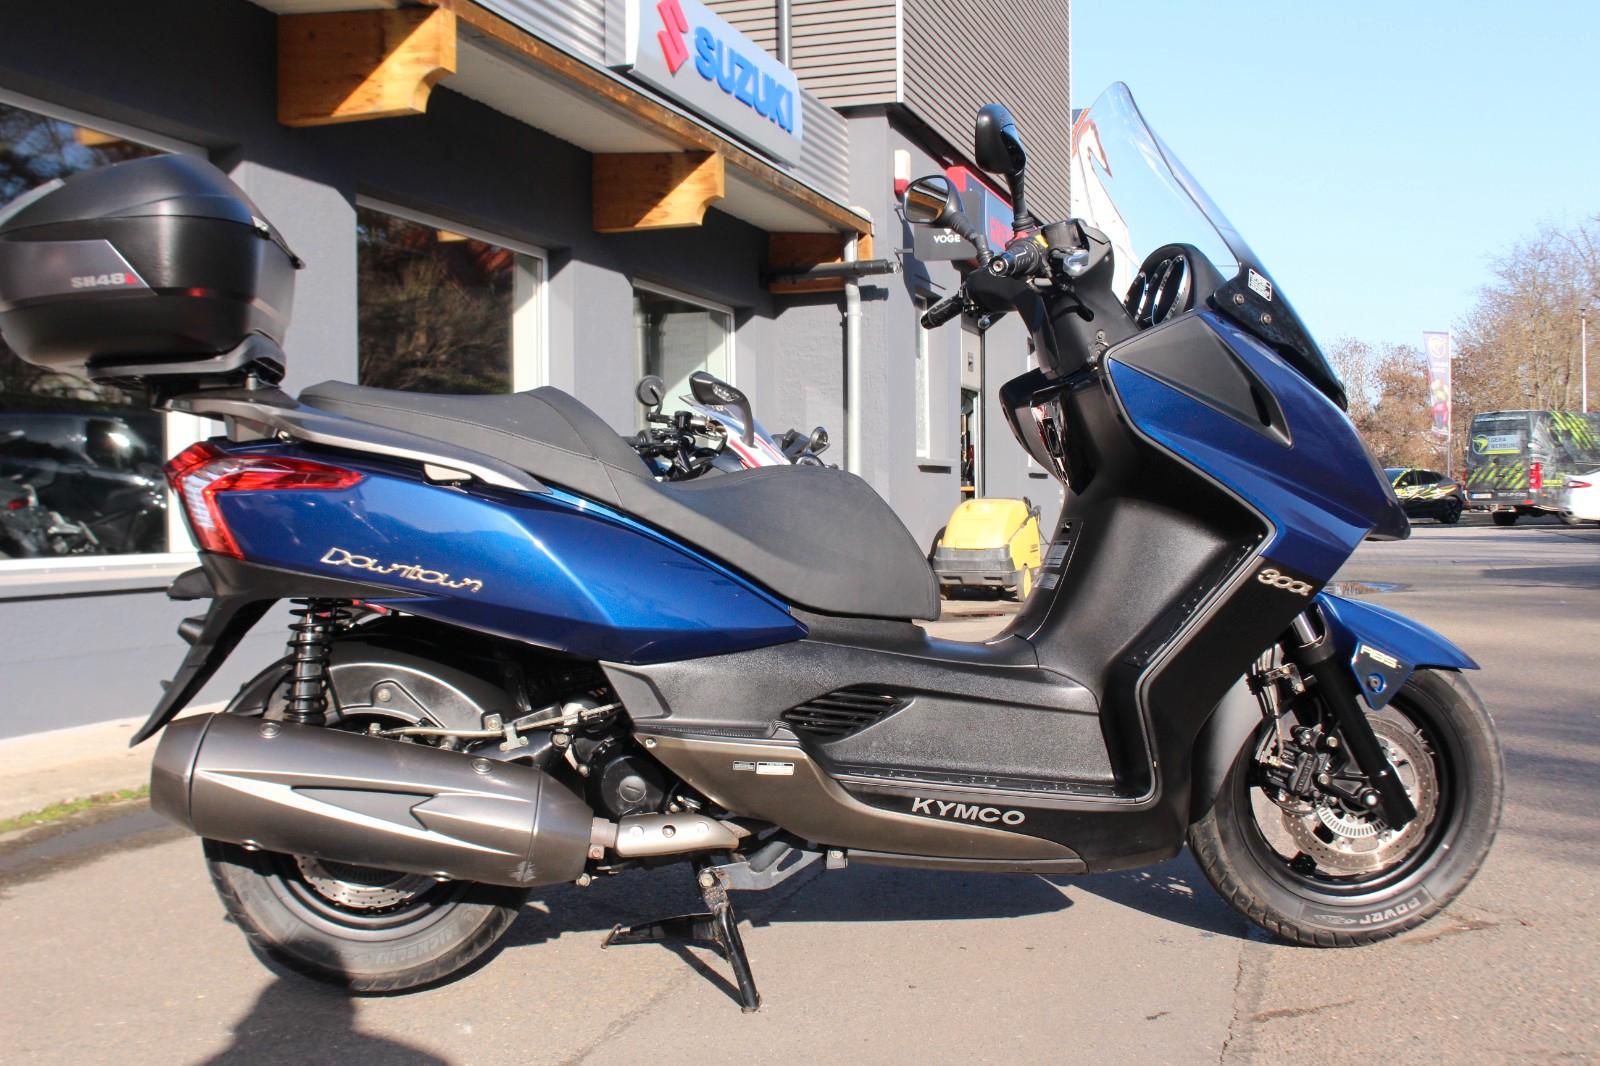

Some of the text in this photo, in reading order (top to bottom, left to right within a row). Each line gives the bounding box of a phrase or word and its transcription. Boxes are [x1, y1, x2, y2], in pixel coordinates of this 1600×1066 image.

[694, 26, 793, 135] SUZUKI
[933, 234, 961, 243] VOGE
[320, 547, 483, 592] Downtown
[1360, 644, 1398, 669] ABS
[911, 797, 1026, 825] KYMCO
